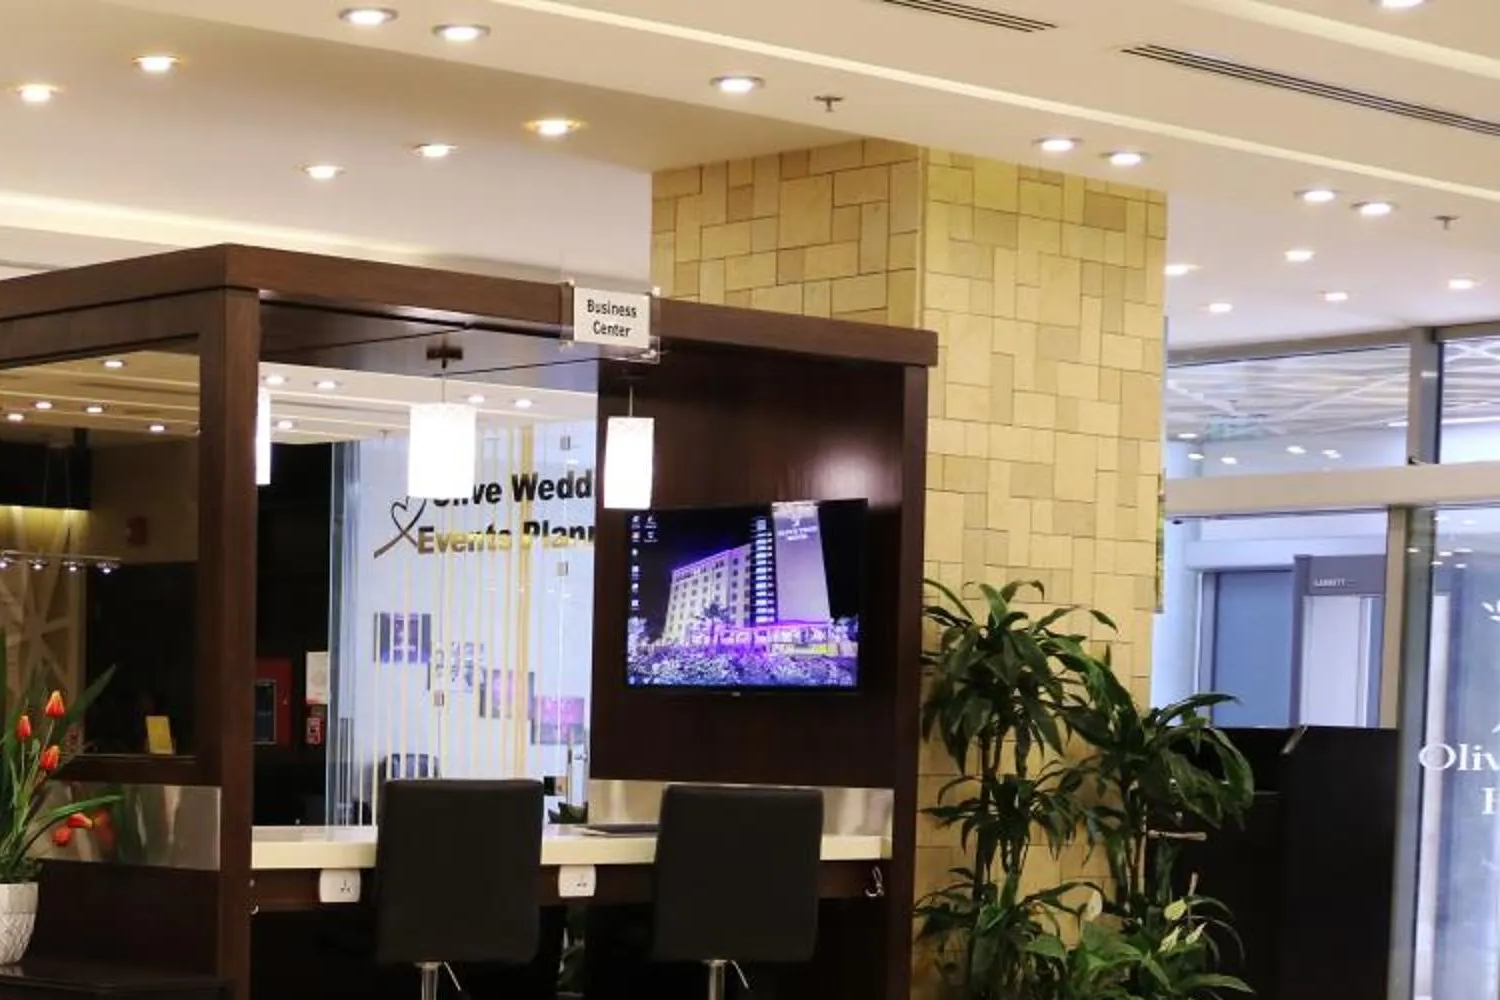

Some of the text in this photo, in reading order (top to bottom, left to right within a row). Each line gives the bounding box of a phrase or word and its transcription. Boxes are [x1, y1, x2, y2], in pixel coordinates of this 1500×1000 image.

[587, 298, 637, 318] Business
[593, 319, 632, 337] Center
[418, 523, 512, 554] Events
